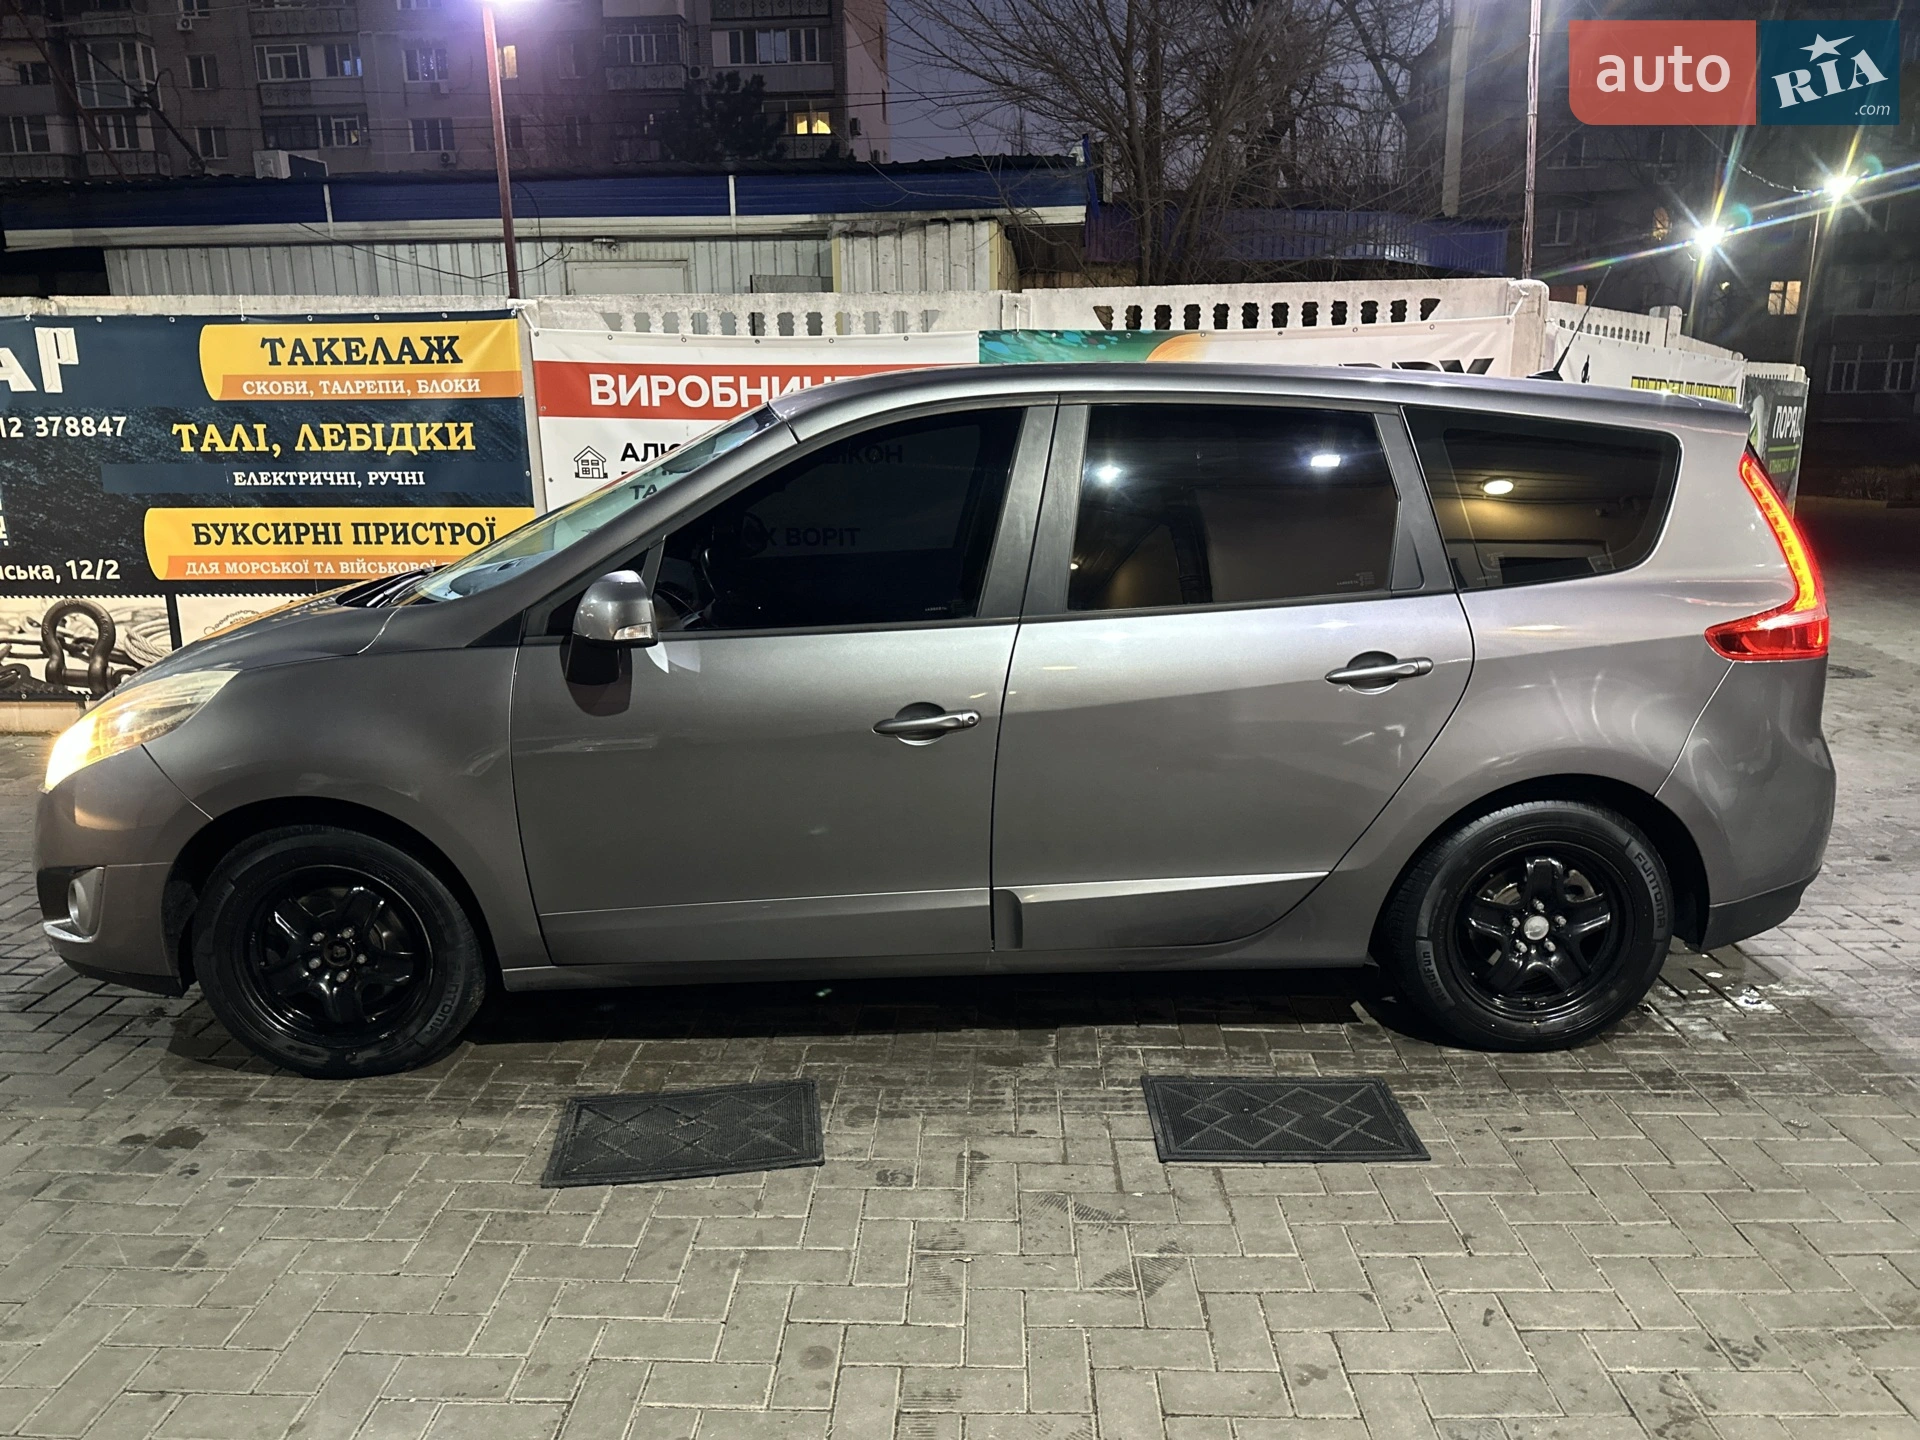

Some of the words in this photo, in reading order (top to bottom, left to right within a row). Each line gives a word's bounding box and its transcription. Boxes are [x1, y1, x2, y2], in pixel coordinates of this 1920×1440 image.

[260, 335, 463, 366] ТАКЕЛАЖ
[242, 380, 314, 397] СКОБИ,
[319, 379, 412, 395] ТАЛРЕПИ,
[417, 378, 481, 393] БЛОКИ
[589, 374, 860, 408] ВИРОБНИ
[34, 415, 127, 437] 378847
[172, 423, 281, 458] ТАЛІ,
[295, 422, 476, 456] ЛЕБІДКИ
[233, 472, 363, 488] ЕЛЕКТРИЧНІ,
[368, 471, 426, 487] РУЧНІ
[192, 522, 343, 545] БУКСИРНІ
[351, 516, 496, 545] ПРИСТРОЇ
[0, 564, 61, 584] ська,
[65, 558, 121, 580] 12/2
[186, 562, 220, 576] ДЛЯ
[225, 558, 309, 575] МОРСЬКОЇ
[314, 562, 334, 575] ТА
